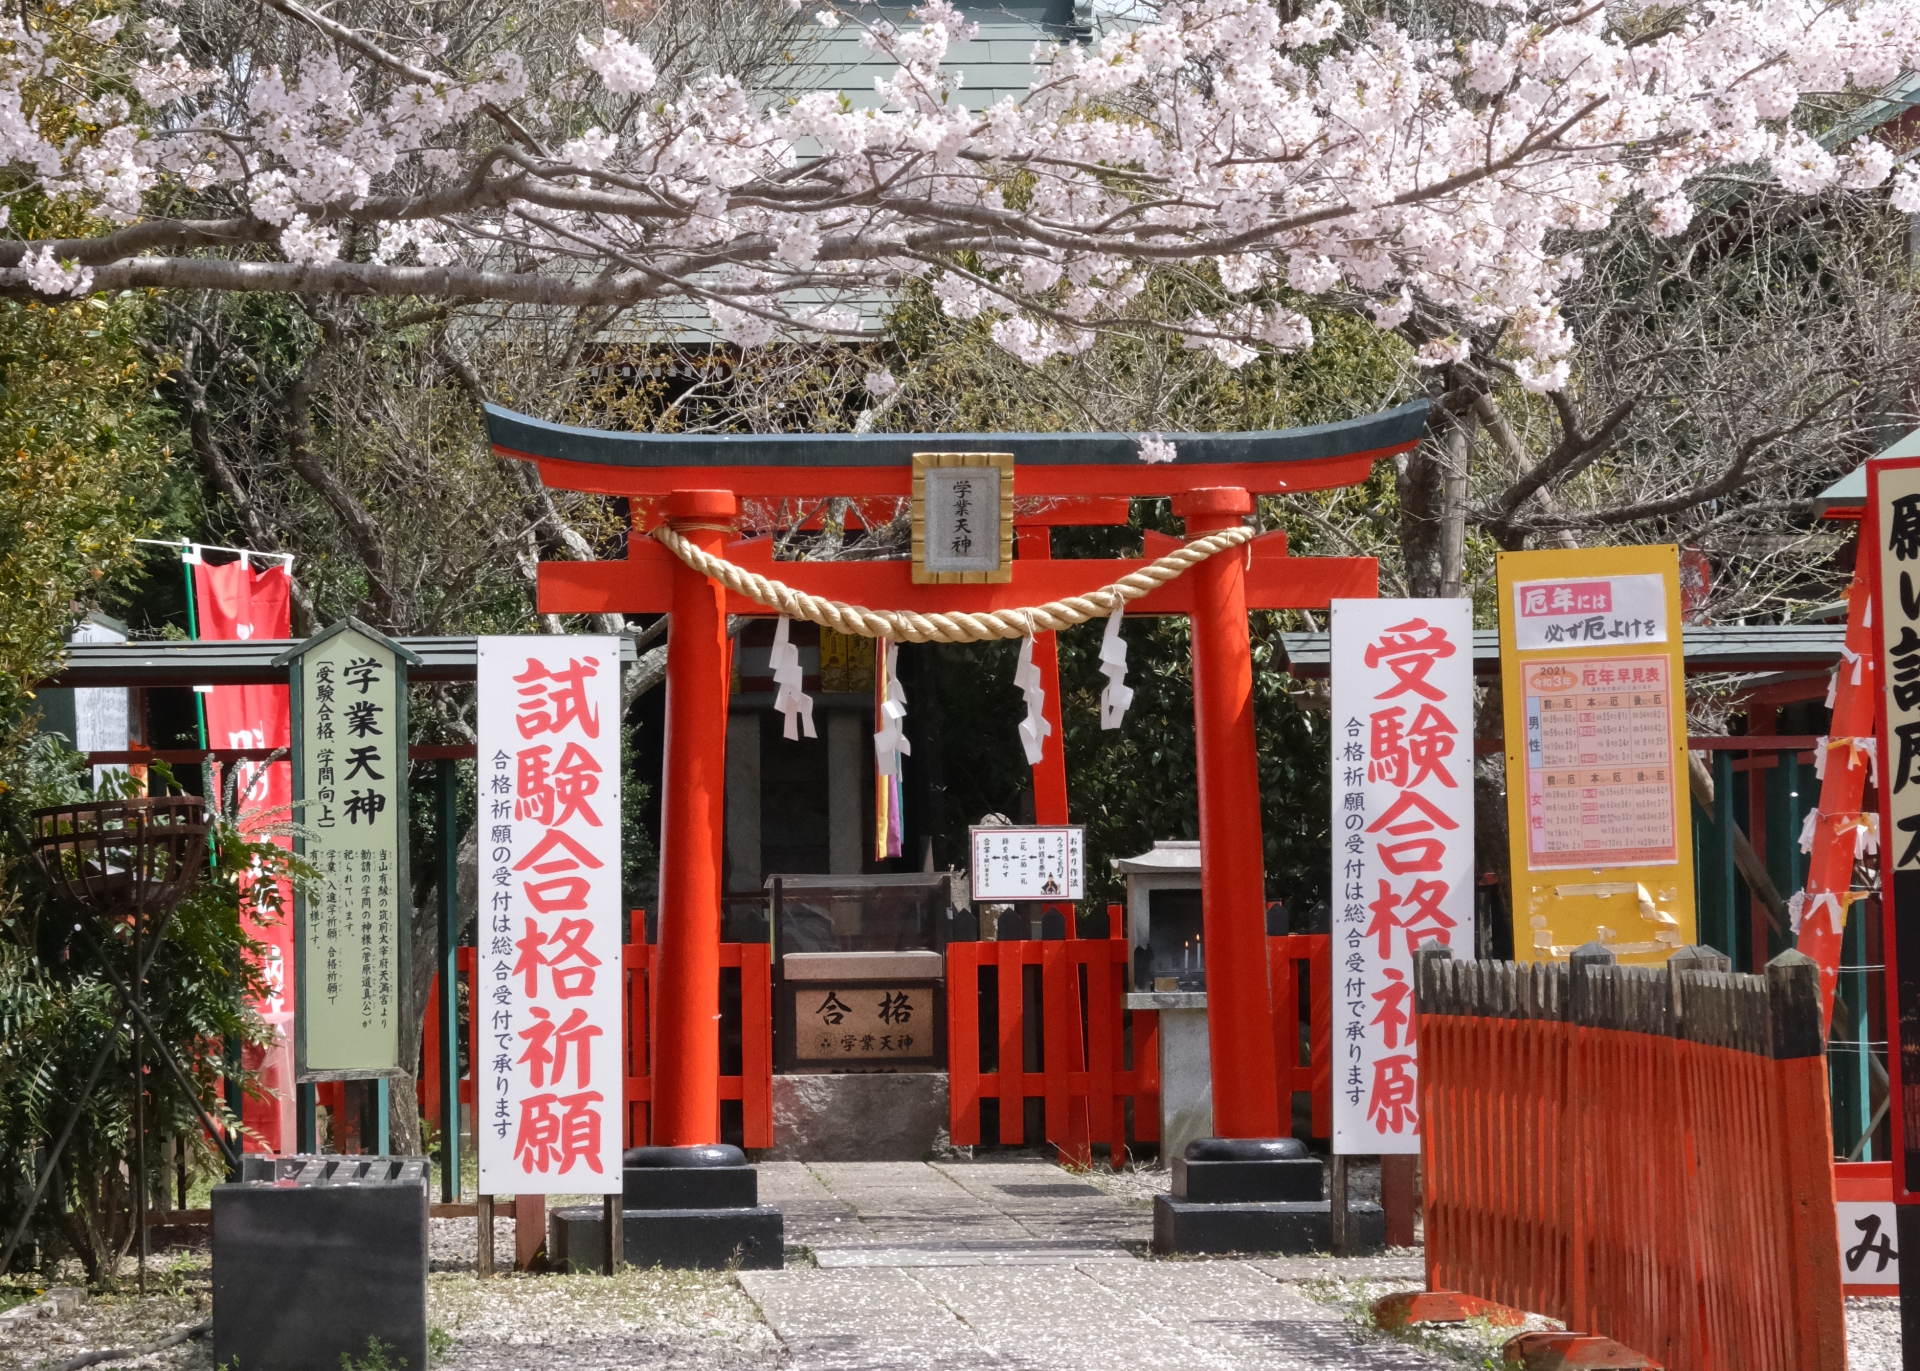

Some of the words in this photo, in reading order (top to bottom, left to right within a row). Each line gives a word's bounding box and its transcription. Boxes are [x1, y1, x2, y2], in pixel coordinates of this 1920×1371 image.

[951, 480, 973, 553] 学業天神
[1524, 587, 1607, 615] 厄年には
[1545, 615, 1656, 643] 必ず厄よけを
[1533, 676, 1572, 688] 令和3年
[1540, 666, 1566, 676] 2021
[1582, 667, 1659, 686] 厄年早見表
[342, 657, 386, 826] 学業天神
[1528, 716, 1541, 753] 男性
[1531, 793, 1544, 830] 女性
[1069, 837, 1079, 887] お参り作法
[511, 655, 604, 1175] 試験合格祈願
[1343, 716, 1366, 1106] 合格祈願の受付は総合受付で承ります
[491, 749, 513, 1139] 合格祈願の受付は総合受付で承ります
[815, 991, 914, 1026] 合格
[840, 1034, 914, 1051] 学業天神
